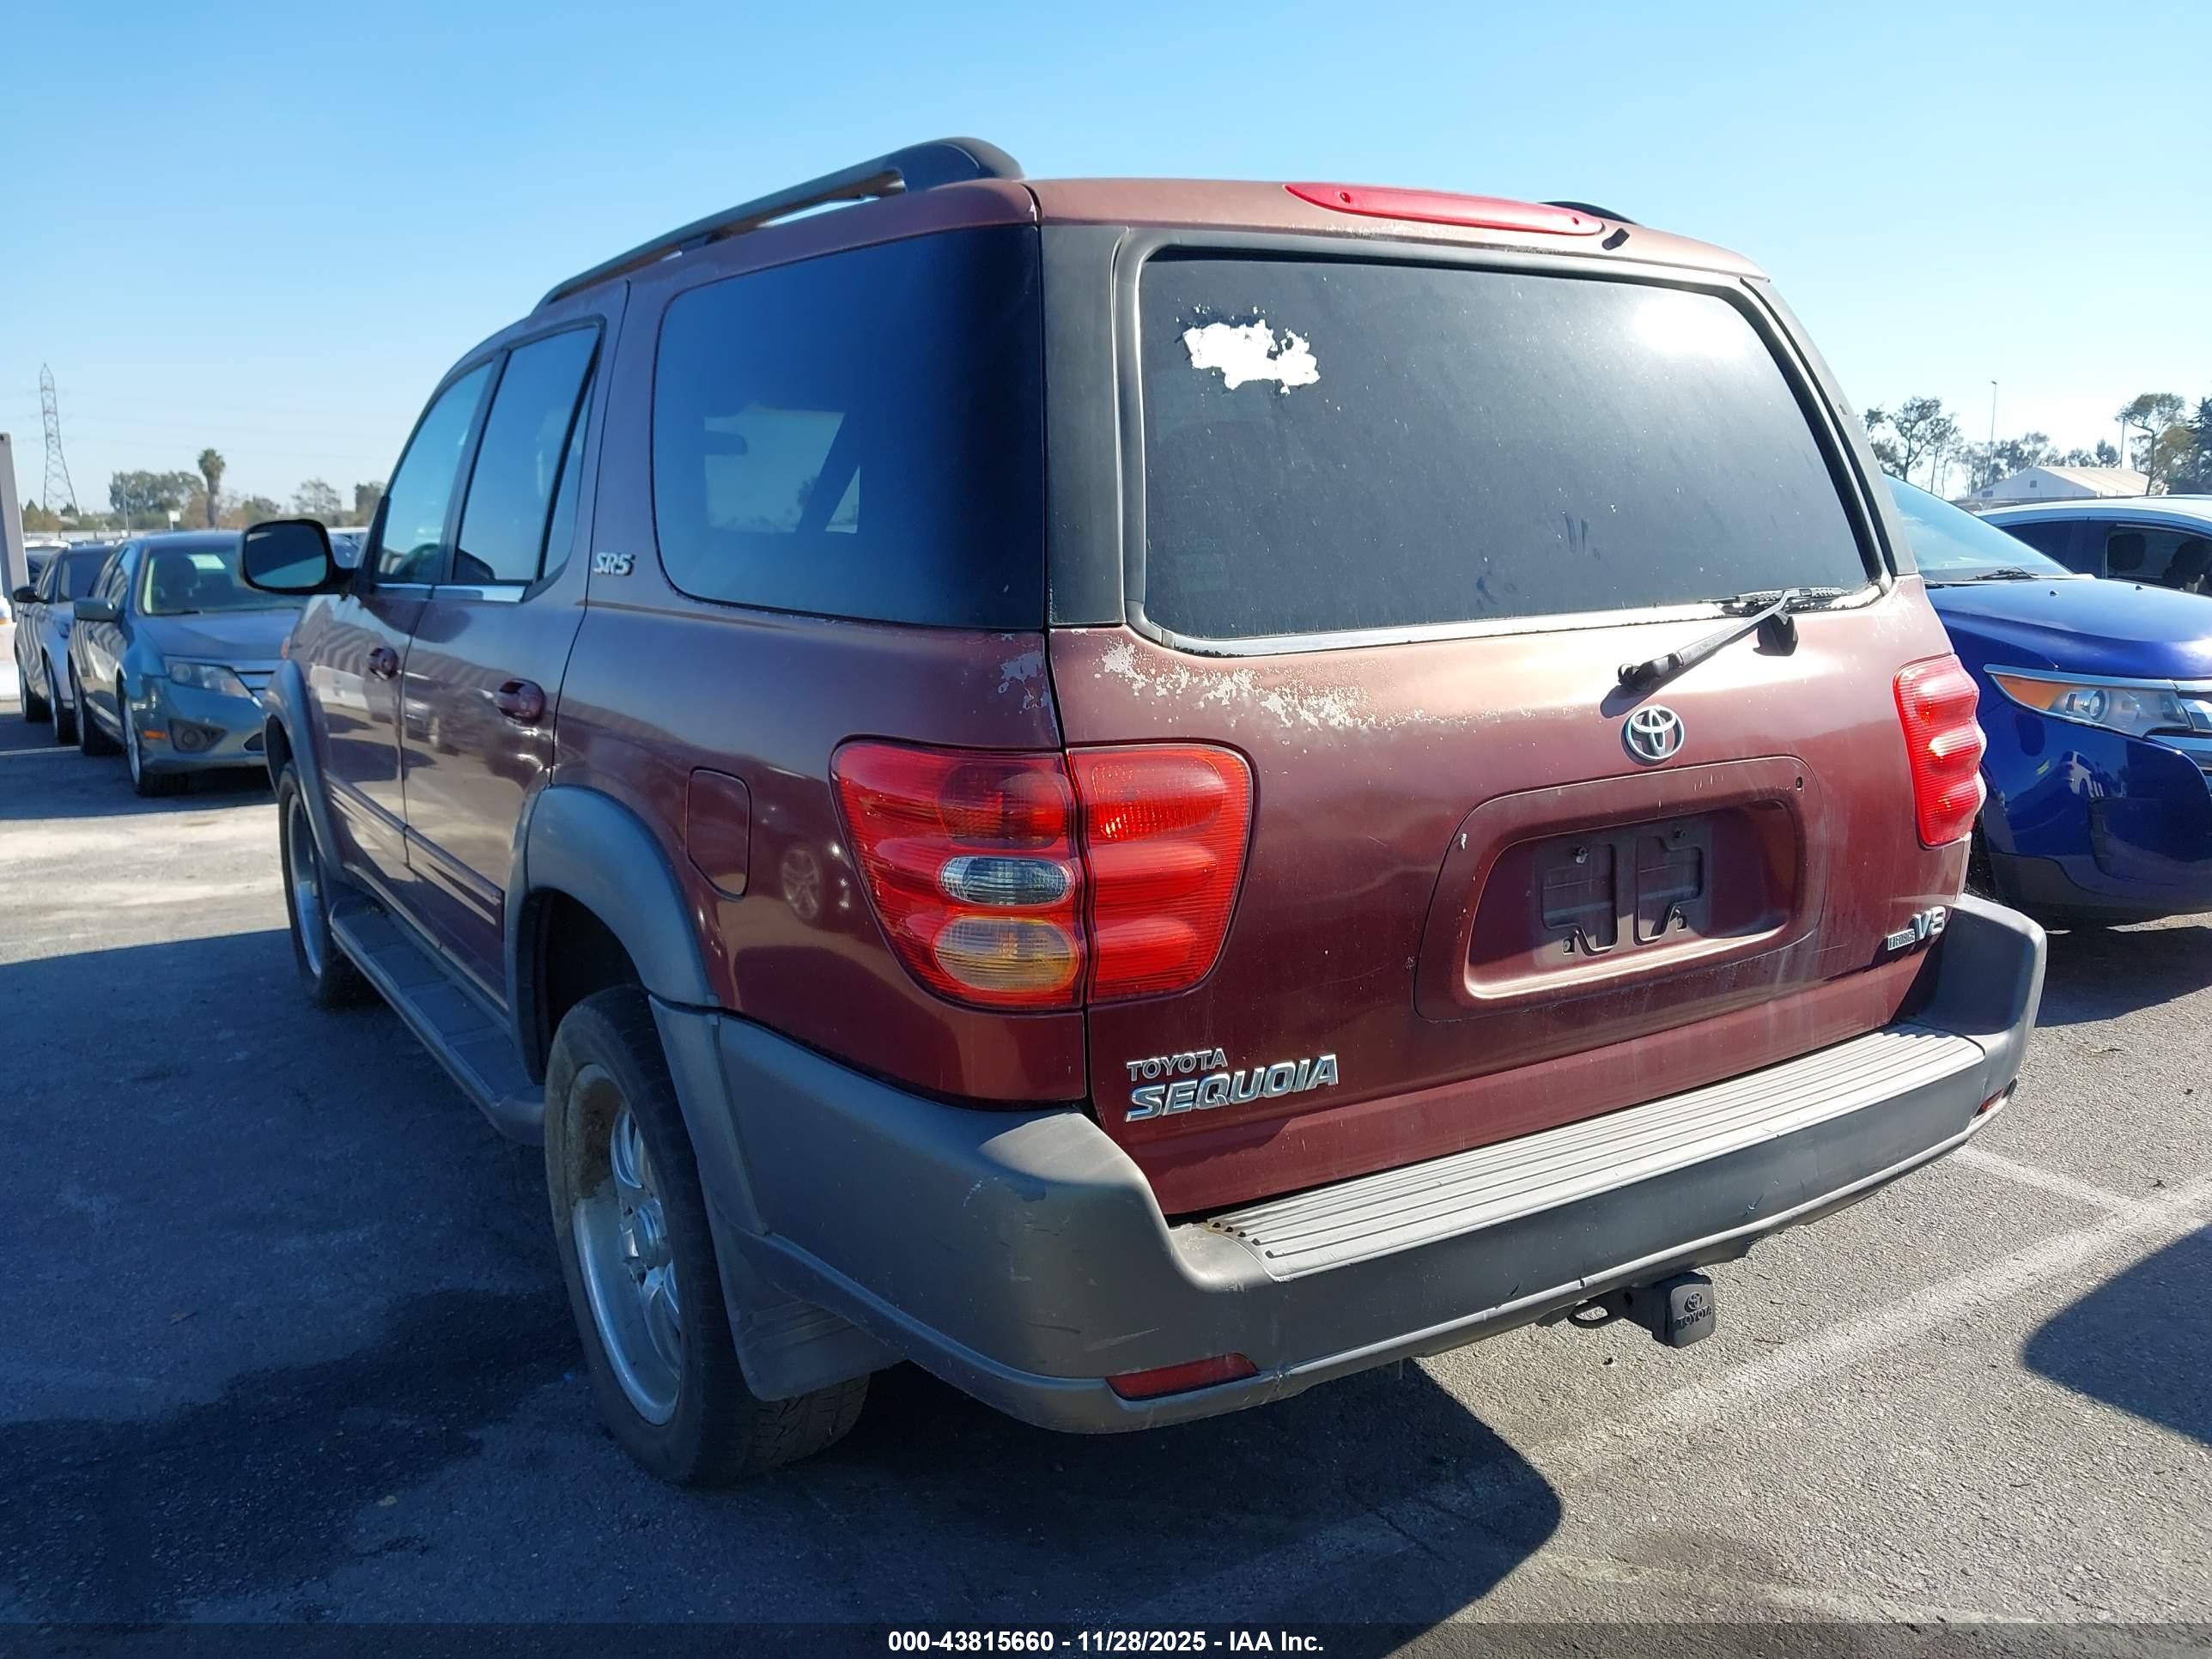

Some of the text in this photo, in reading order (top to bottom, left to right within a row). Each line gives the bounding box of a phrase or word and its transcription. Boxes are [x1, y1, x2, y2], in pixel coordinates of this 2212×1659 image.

[593, 552, 633, 575] SR5
[1911, 906, 1946, 939] V8
[1126, 1048, 1228, 1082] TOYOTA
[1125, 1054, 1339, 1122] SEQUOIA
[1675, 1304, 1712, 1328] TOYOTA
